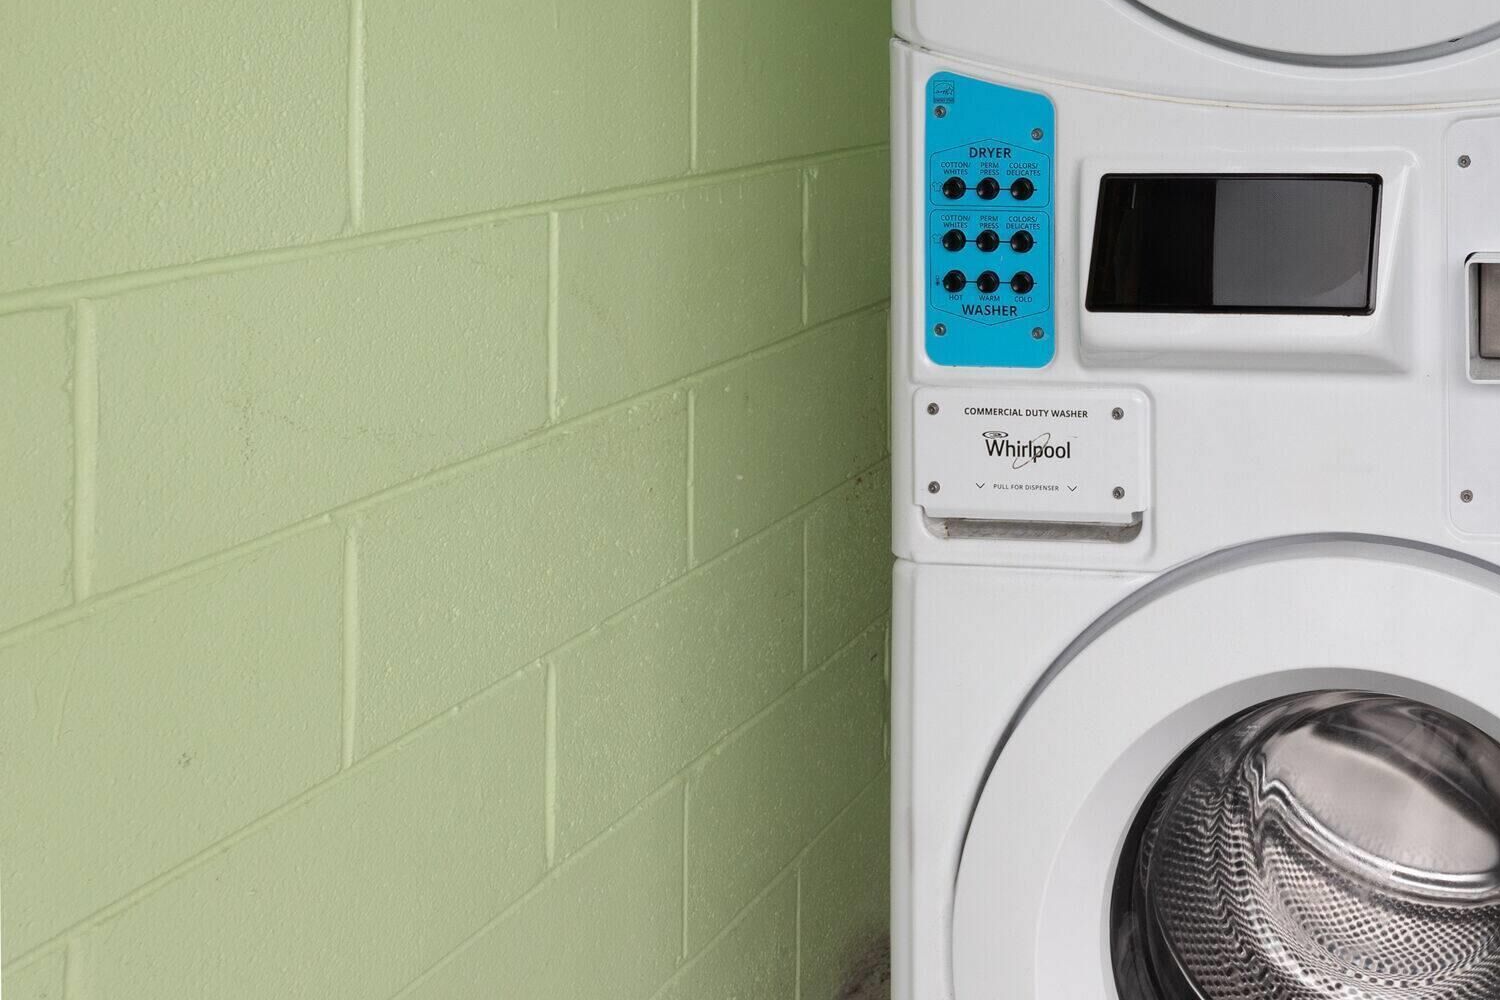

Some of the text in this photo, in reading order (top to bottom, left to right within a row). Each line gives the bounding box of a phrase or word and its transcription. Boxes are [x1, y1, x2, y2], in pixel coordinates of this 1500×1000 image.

[969, 147, 1012, 158] DRYER
[962, 304, 1018, 316] WASHER
[964, 407, 1088, 418] COMMERCIAL DUTY WASHER
[985, 439, 1071, 463] Whirlpool
[1025, 484, 1059, 492] DISPENSER
